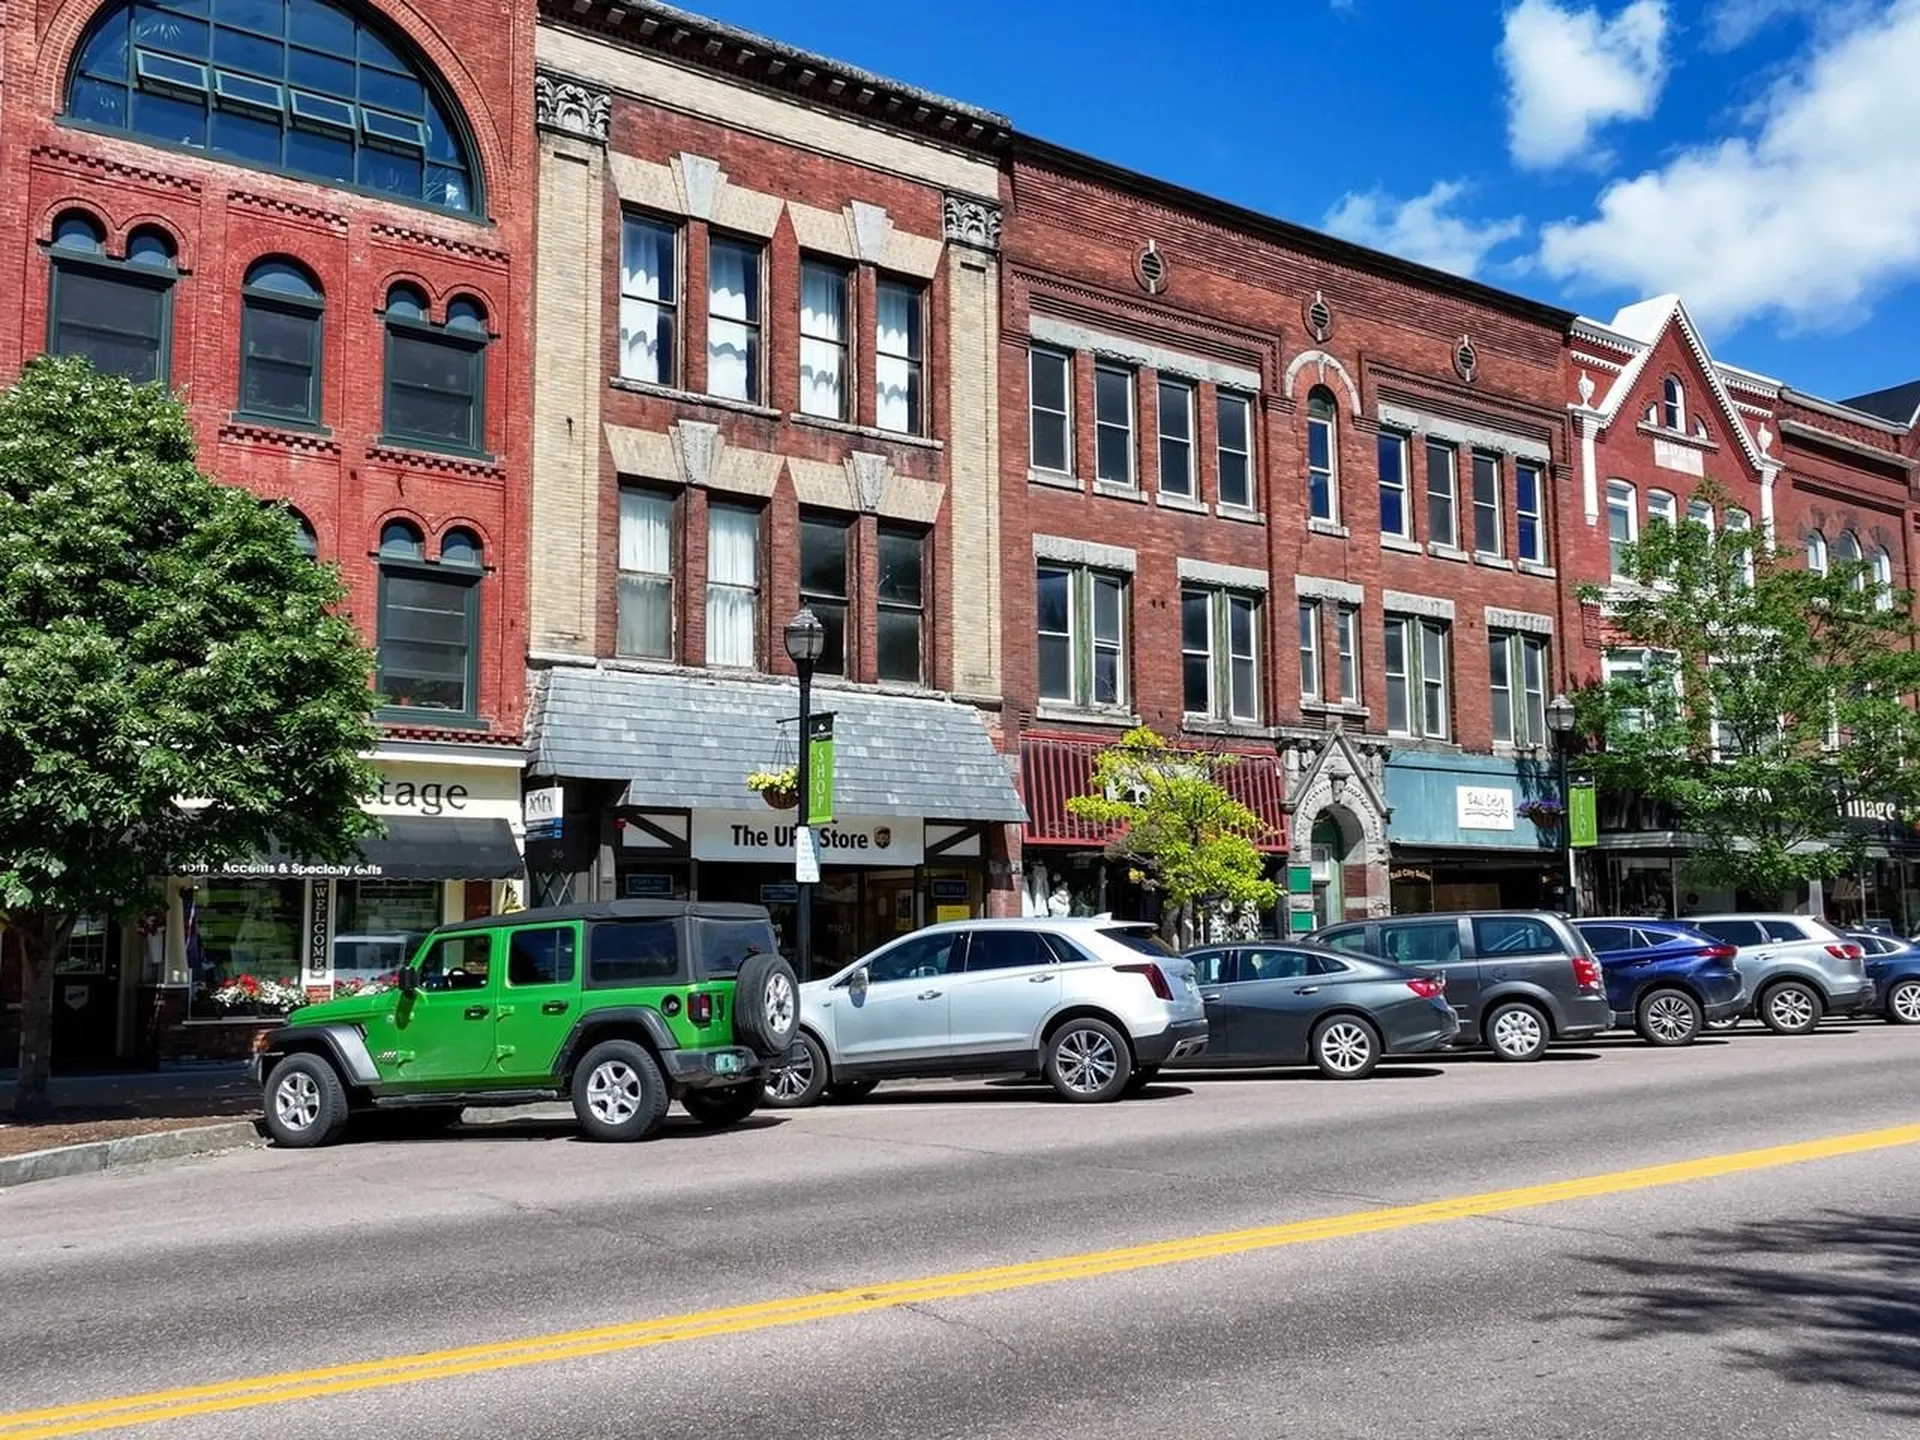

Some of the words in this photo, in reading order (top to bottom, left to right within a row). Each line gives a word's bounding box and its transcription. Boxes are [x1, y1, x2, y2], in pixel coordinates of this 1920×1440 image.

[815, 746, 827, 810] SHOP
[731, 824, 768, 847] The
[774, 826, 798, 848] UP
[819, 827, 869, 849] Store
[277, 863, 289, 874] &
[312, 887, 327, 971] WELCOME
